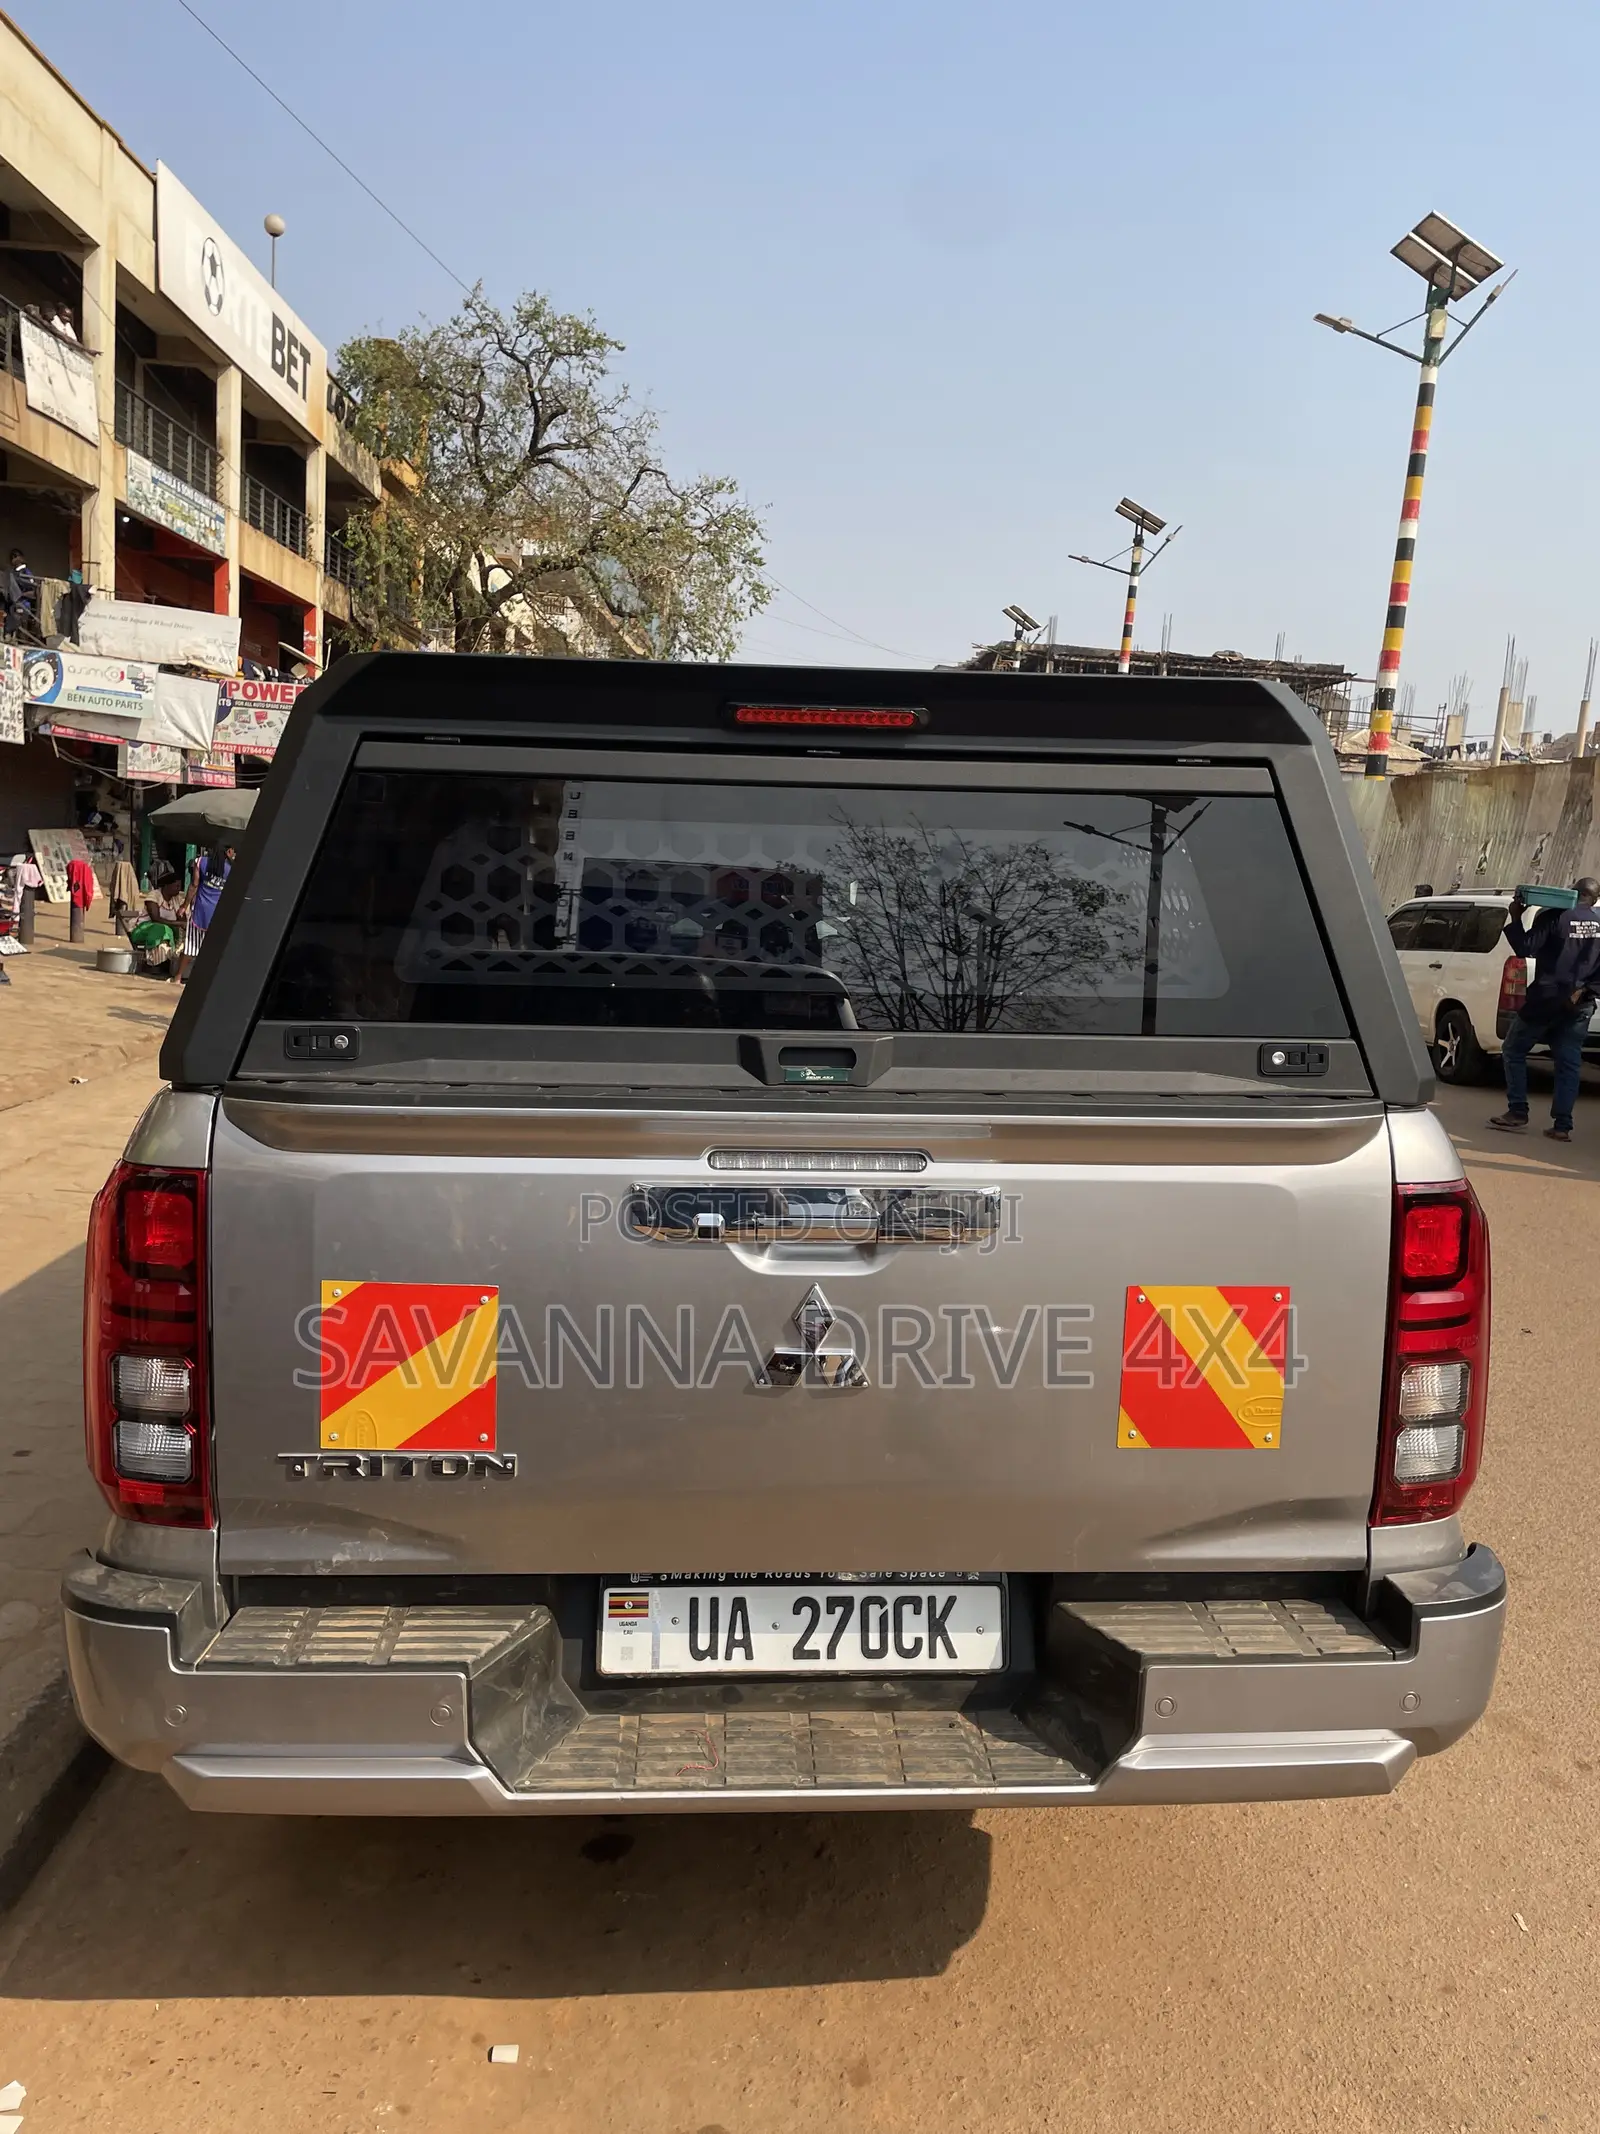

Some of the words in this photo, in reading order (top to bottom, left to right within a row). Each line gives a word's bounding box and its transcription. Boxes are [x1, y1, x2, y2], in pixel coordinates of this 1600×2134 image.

[67, 692, 86, 704] BEN
[87, 694, 113, 708] AUTO
[115, 698, 144, 711] PARTS
[278, 1453, 518, 1478] TRITON
[689, 1596, 754, 1662] UA
[792, 1595, 958, 1661] 270CK
